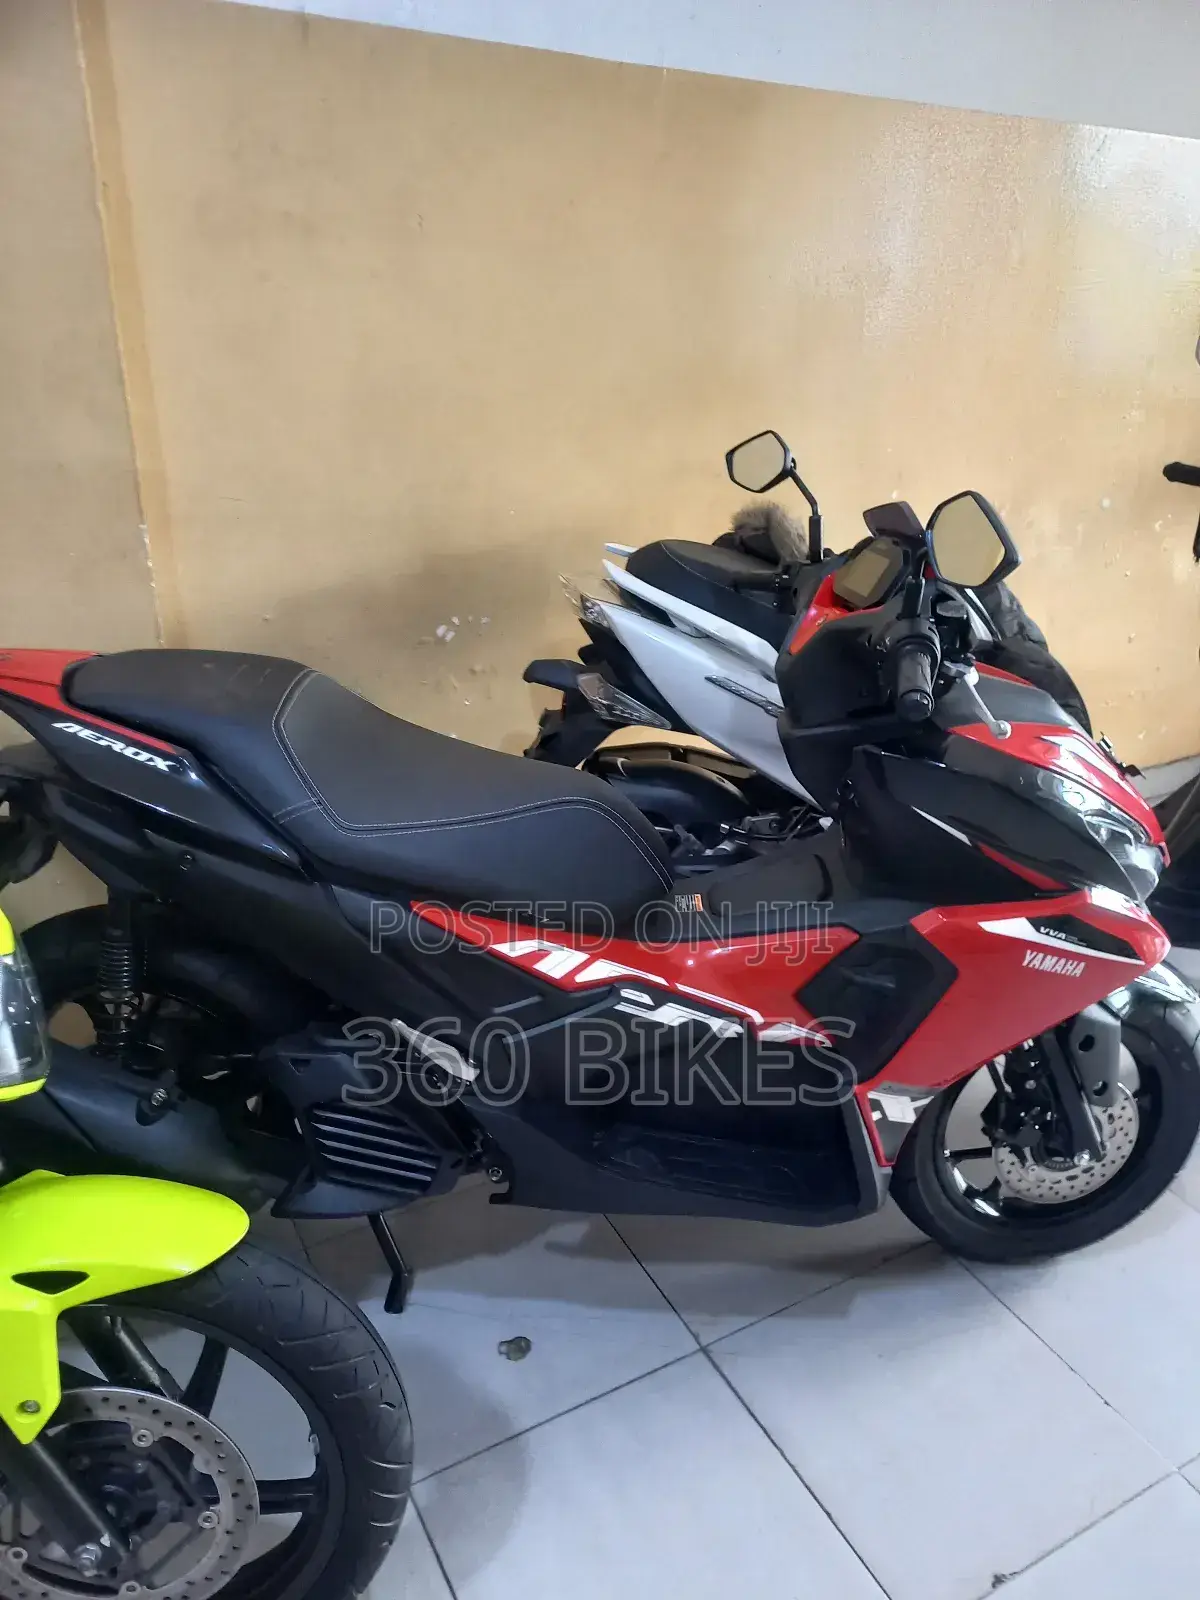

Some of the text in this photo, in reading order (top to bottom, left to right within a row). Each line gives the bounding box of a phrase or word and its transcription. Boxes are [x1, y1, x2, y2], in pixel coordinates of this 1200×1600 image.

[51, 722, 176, 772] AEROX
[1040, 926, 1066, 940] VVA
[1022, 949, 1086, 977] YAMAHA
